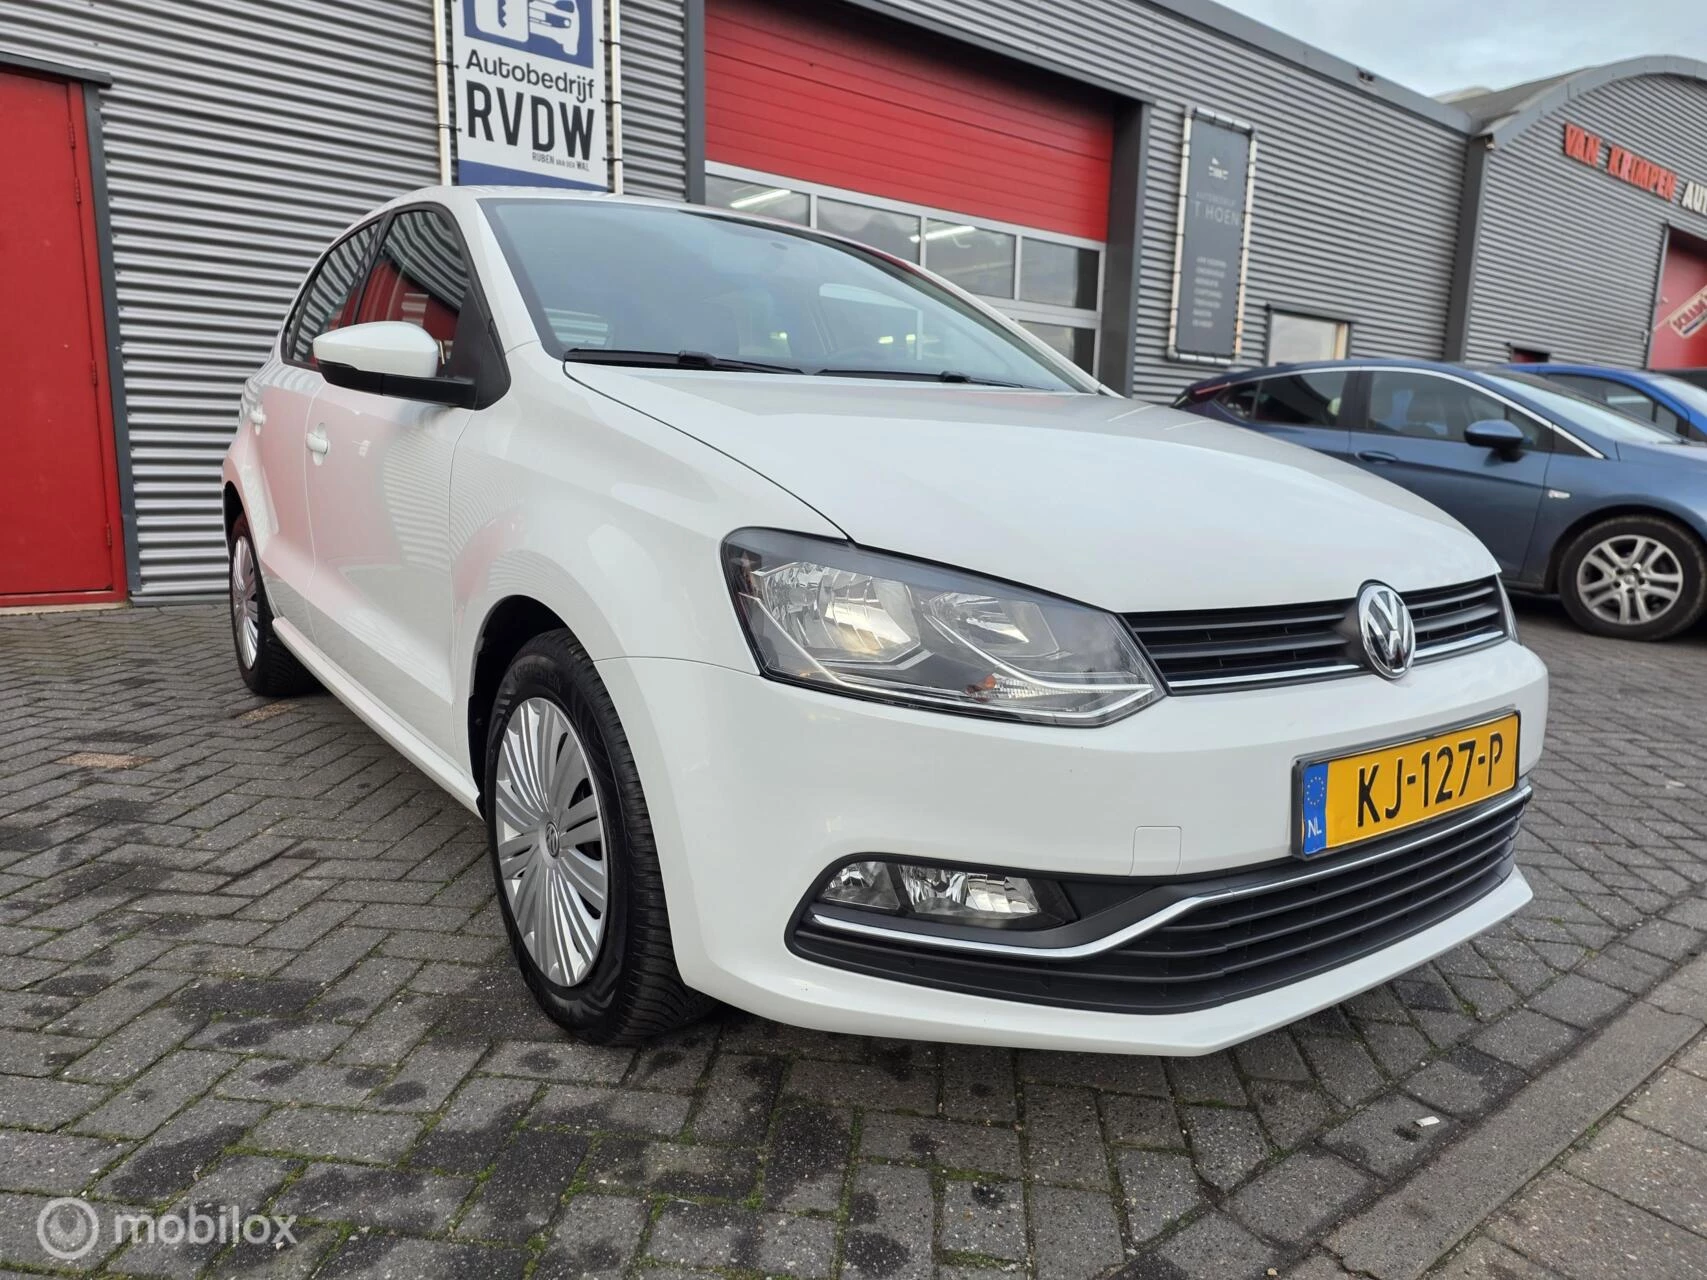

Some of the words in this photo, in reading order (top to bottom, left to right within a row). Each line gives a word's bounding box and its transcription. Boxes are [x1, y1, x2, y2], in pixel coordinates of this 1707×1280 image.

[466, 49, 595, 103] Autobedrijf
[466, 79, 595, 161] RVDW
[532, 151, 555, 165] RUBEN
[1564, 121, 1601, 168] VAN
[1205, 203, 1241, 226] HOEN
[1357, 732, 1504, 828] KJ-127-P
[1307, 819, 1323, 838] NL
